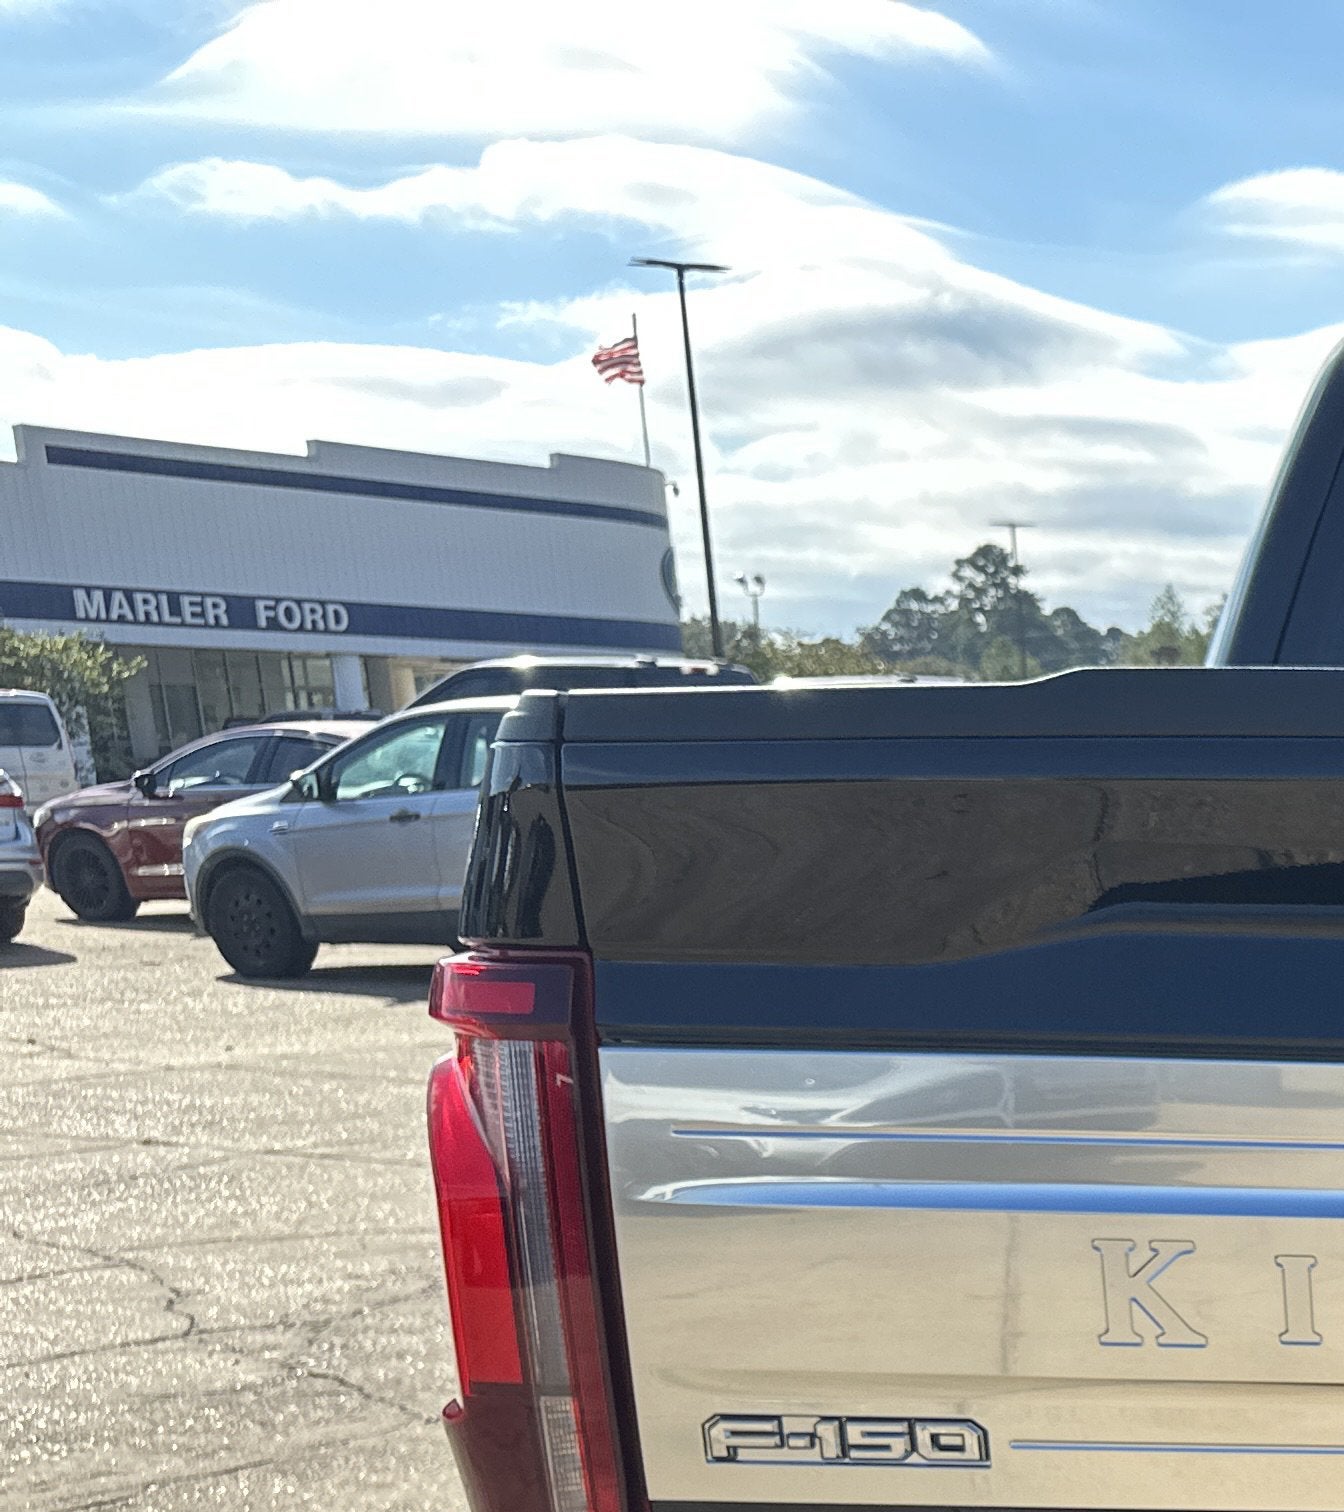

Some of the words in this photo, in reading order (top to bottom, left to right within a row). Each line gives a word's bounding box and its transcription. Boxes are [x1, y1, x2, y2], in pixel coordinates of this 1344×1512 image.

[72, 588, 229, 627] MARLER
[254, 600, 350, 633] FORD
[702, 1414, 991, 1468] F-150
